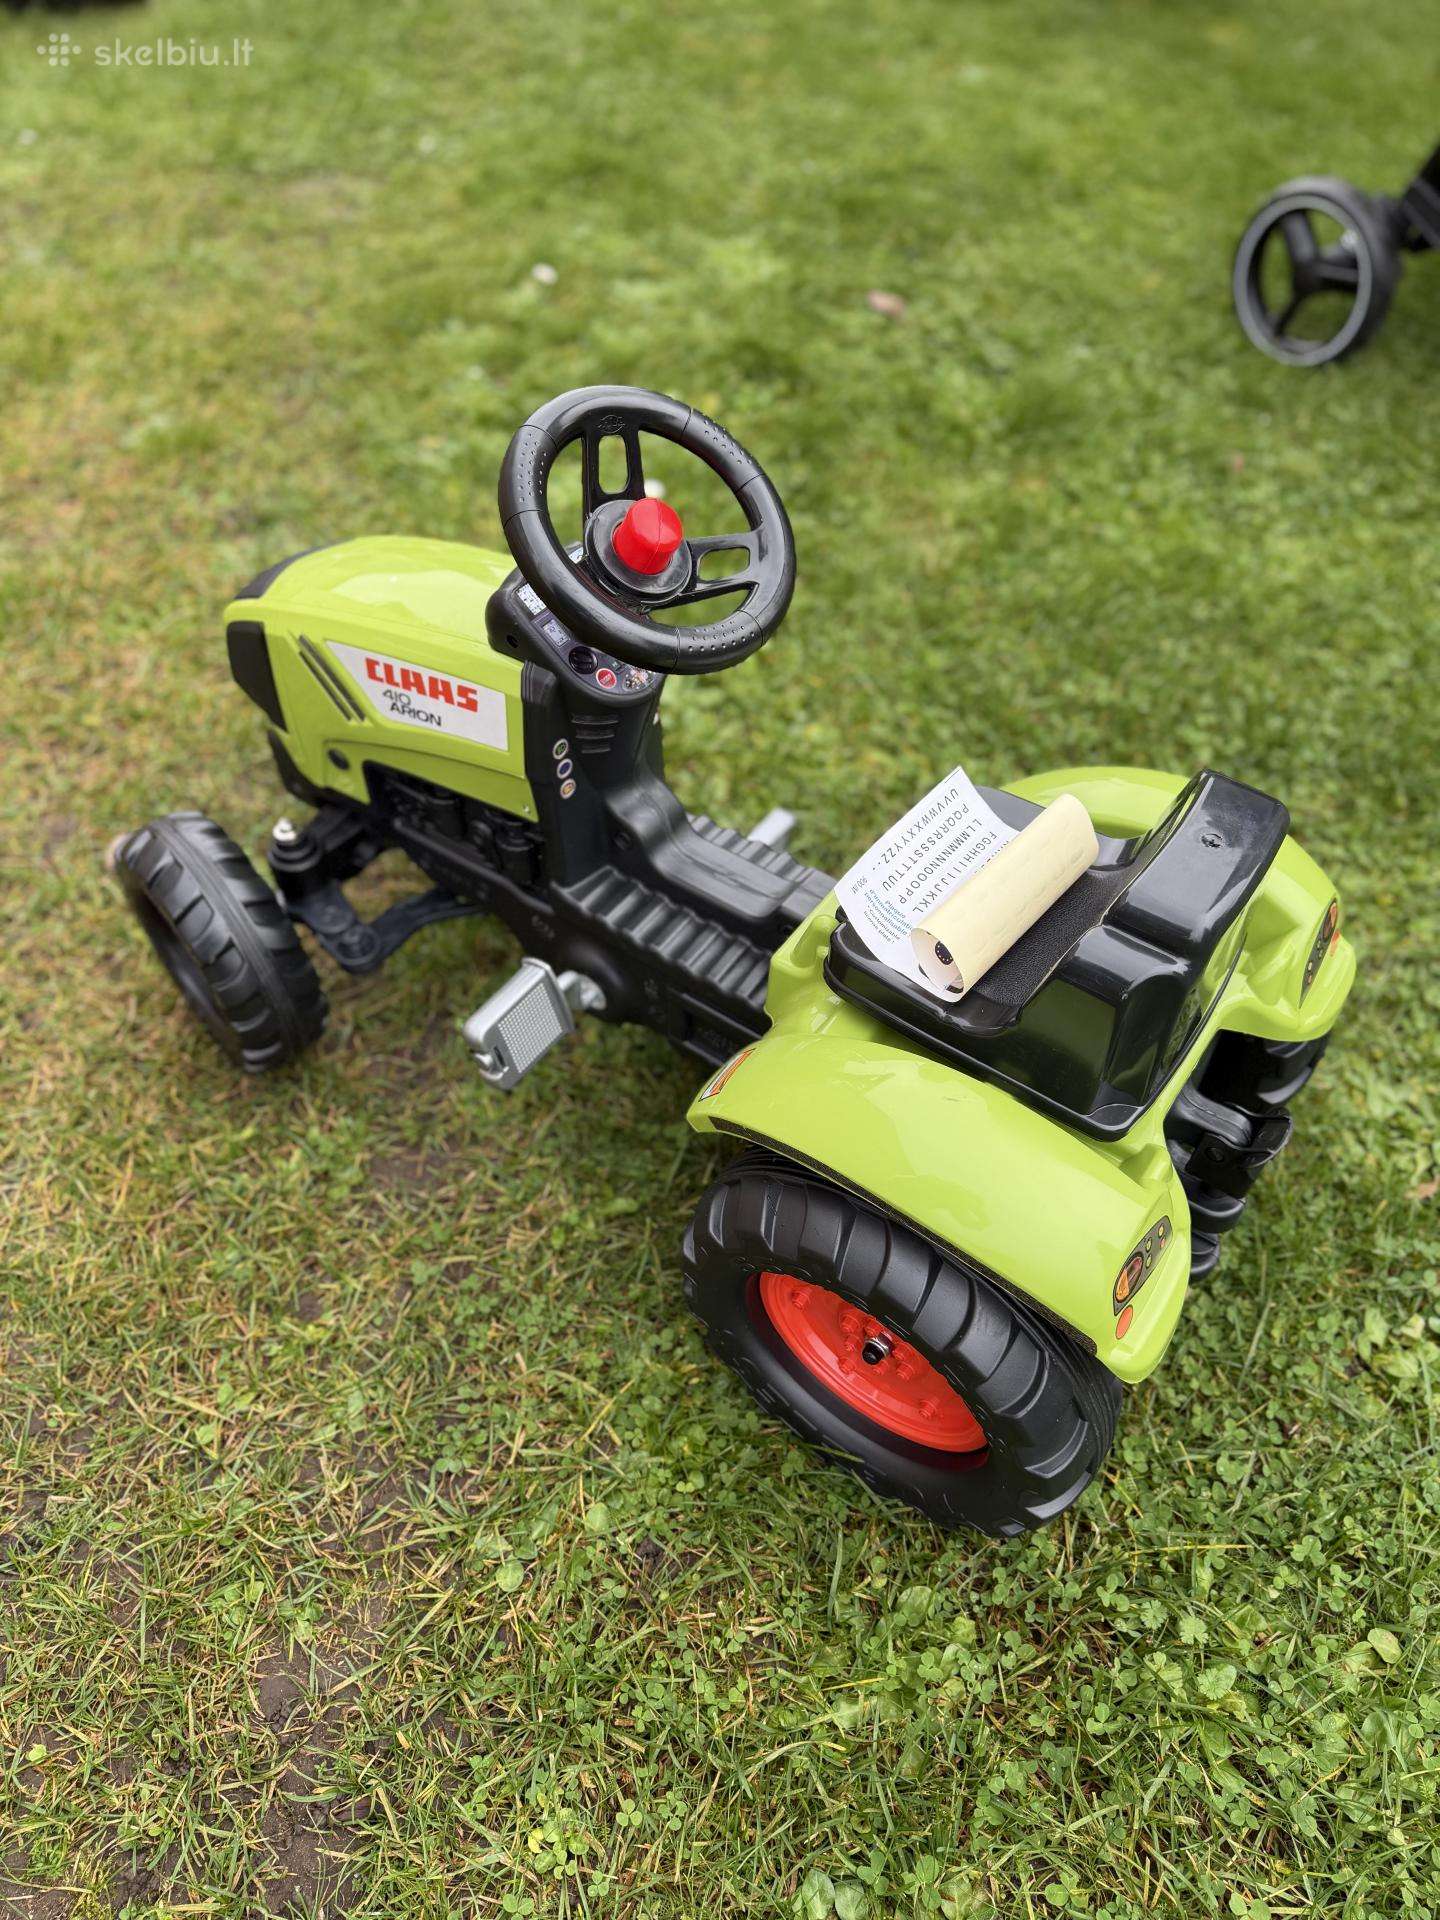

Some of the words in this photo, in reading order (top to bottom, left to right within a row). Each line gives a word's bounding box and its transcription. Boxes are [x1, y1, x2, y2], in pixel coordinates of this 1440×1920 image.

[365, 657, 478, 713] CLAAS
[383, 689, 411, 706] 410
[390, 703, 442, 727] ARION
